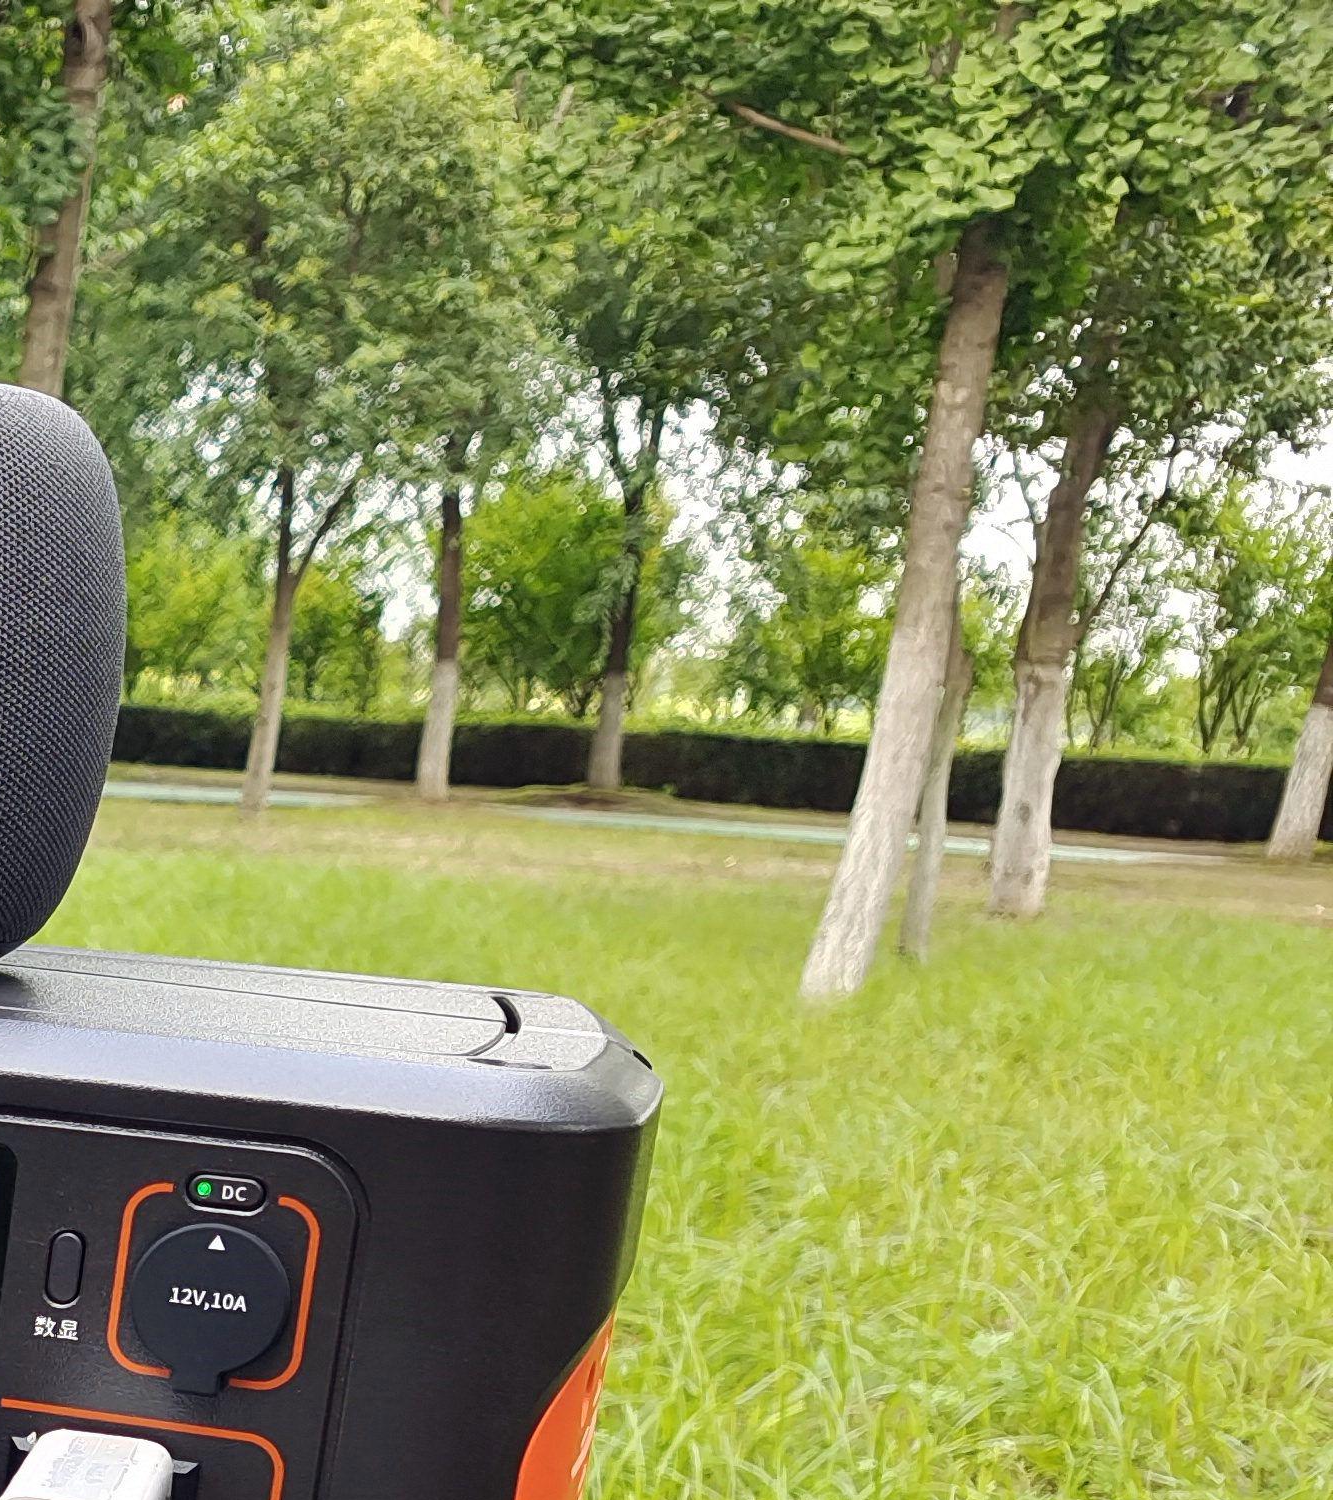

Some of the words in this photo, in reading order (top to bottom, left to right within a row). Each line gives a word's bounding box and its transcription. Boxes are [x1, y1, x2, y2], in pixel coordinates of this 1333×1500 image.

[221, 1185, 247, 1201] DC
[169, 1287, 247, 1312] 12V,10A
[33, 1315, 79, 1341] 数显
